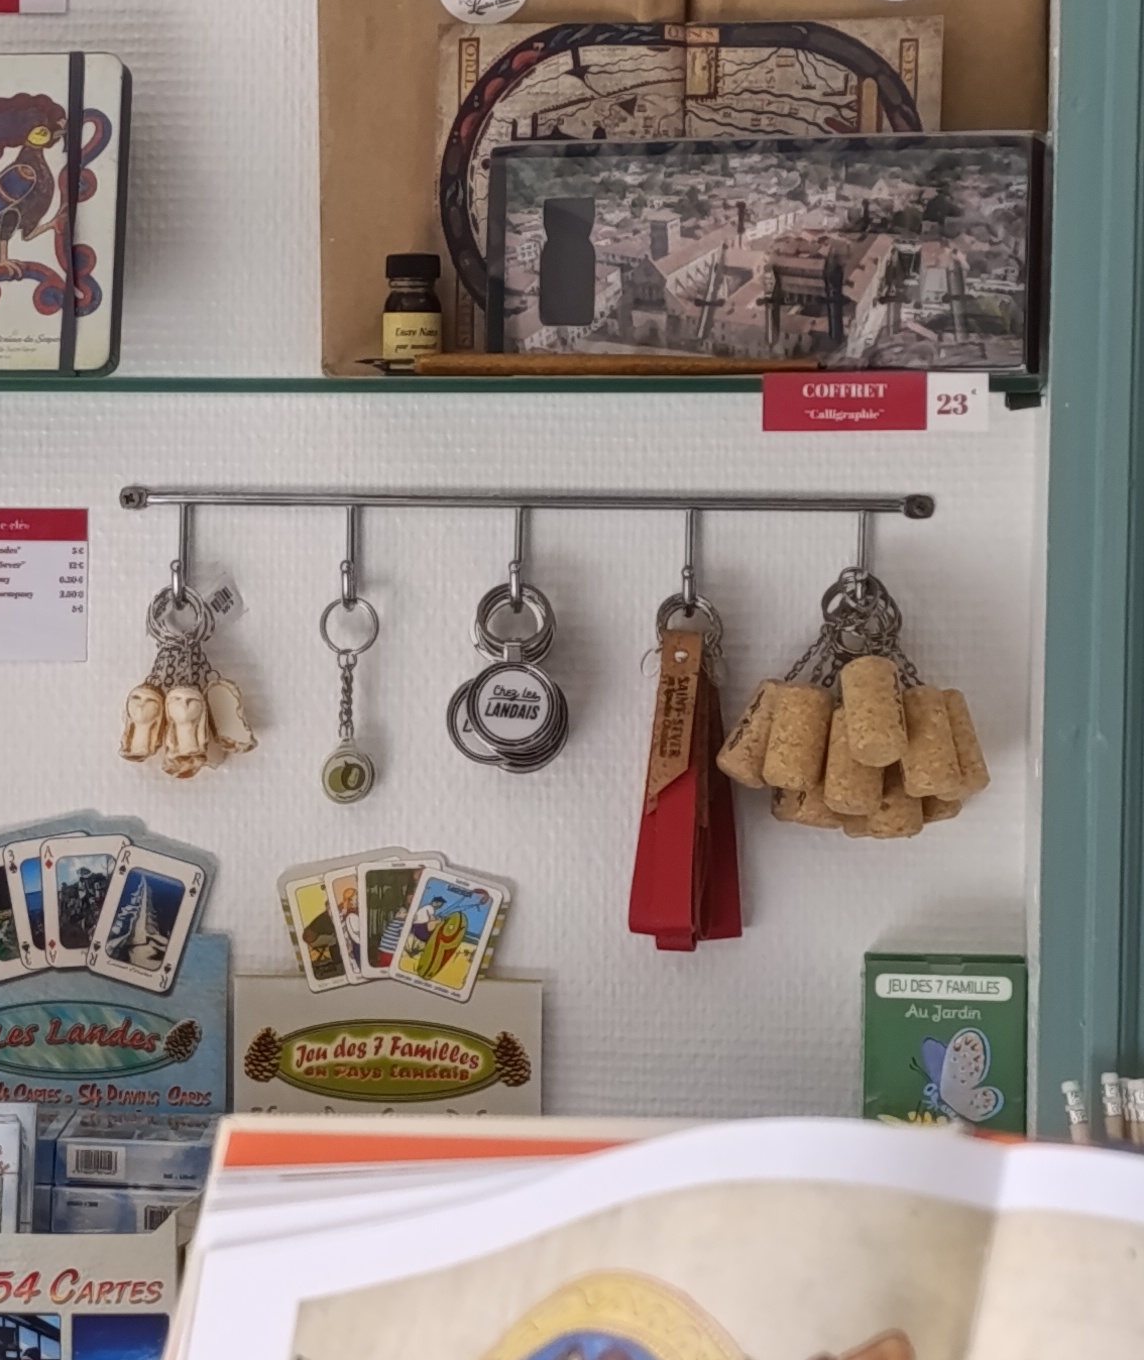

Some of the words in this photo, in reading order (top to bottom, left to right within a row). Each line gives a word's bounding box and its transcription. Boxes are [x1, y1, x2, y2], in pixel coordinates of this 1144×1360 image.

[802, 383, 887, 398] COFFRET
[485, 702, 540, 720] LANDAIS
[887, 979, 907, 994] JEU
[910, 979, 934, 993] DES
[935, 979, 944, 992] 7
[946, 980, 1001, 995] FAMILLES
[905, 1004, 929, 1018] Au
[932, 1005, 982, 1022] Jardin
[46, 1018, 158, 1052] Landes
[296, 1045, 328, 1066] Jeu
[333, 1037, 367, 1058] des
[373, 1037, 384, 1056] 7
[390, 1037, 480, 1069] Familles
[304, 1065, 327, 1077] en
[334, 1064, 383, 1080] Pays
[389, 1065, 470, 1081] Landais
[50, 1268, 164, 1304] CARTES
